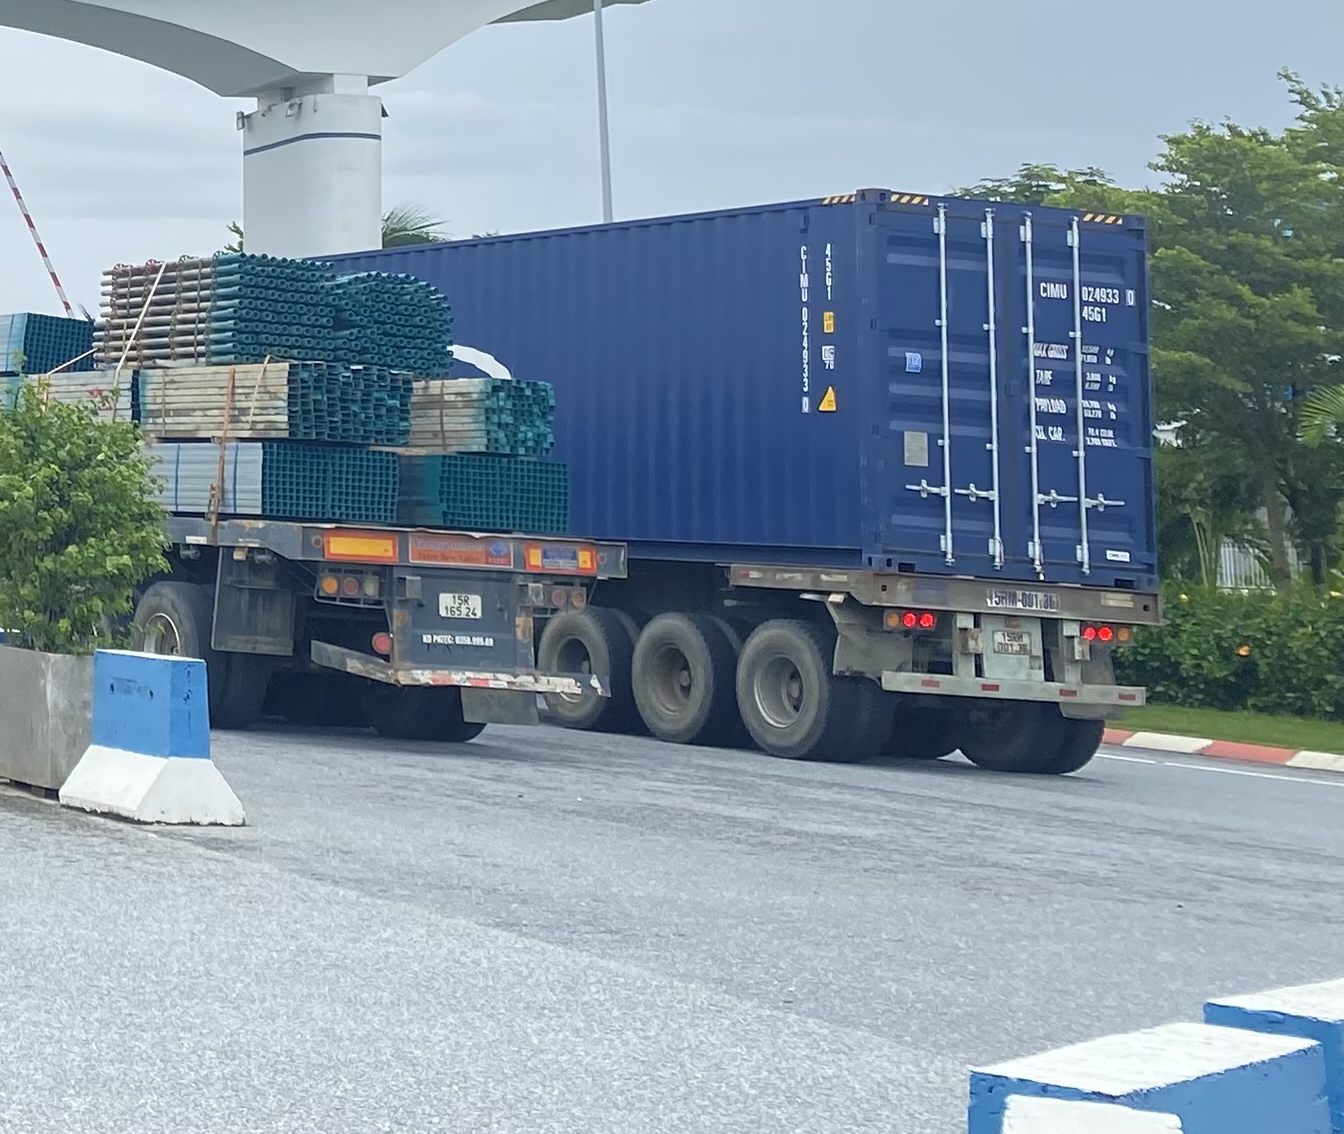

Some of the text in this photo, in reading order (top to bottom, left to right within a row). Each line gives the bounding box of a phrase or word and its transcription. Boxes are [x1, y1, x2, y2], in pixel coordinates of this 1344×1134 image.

[799, 245, 809, 302] CIMU
[825, 242, 833, 300] 45G1
[1040, 282, 1067, 299] CIMU
[1081, 286, 1119, 304] 024933
[1082, 306, 1106, 322] 45G1
[452, 595, 470, 606] 15R
